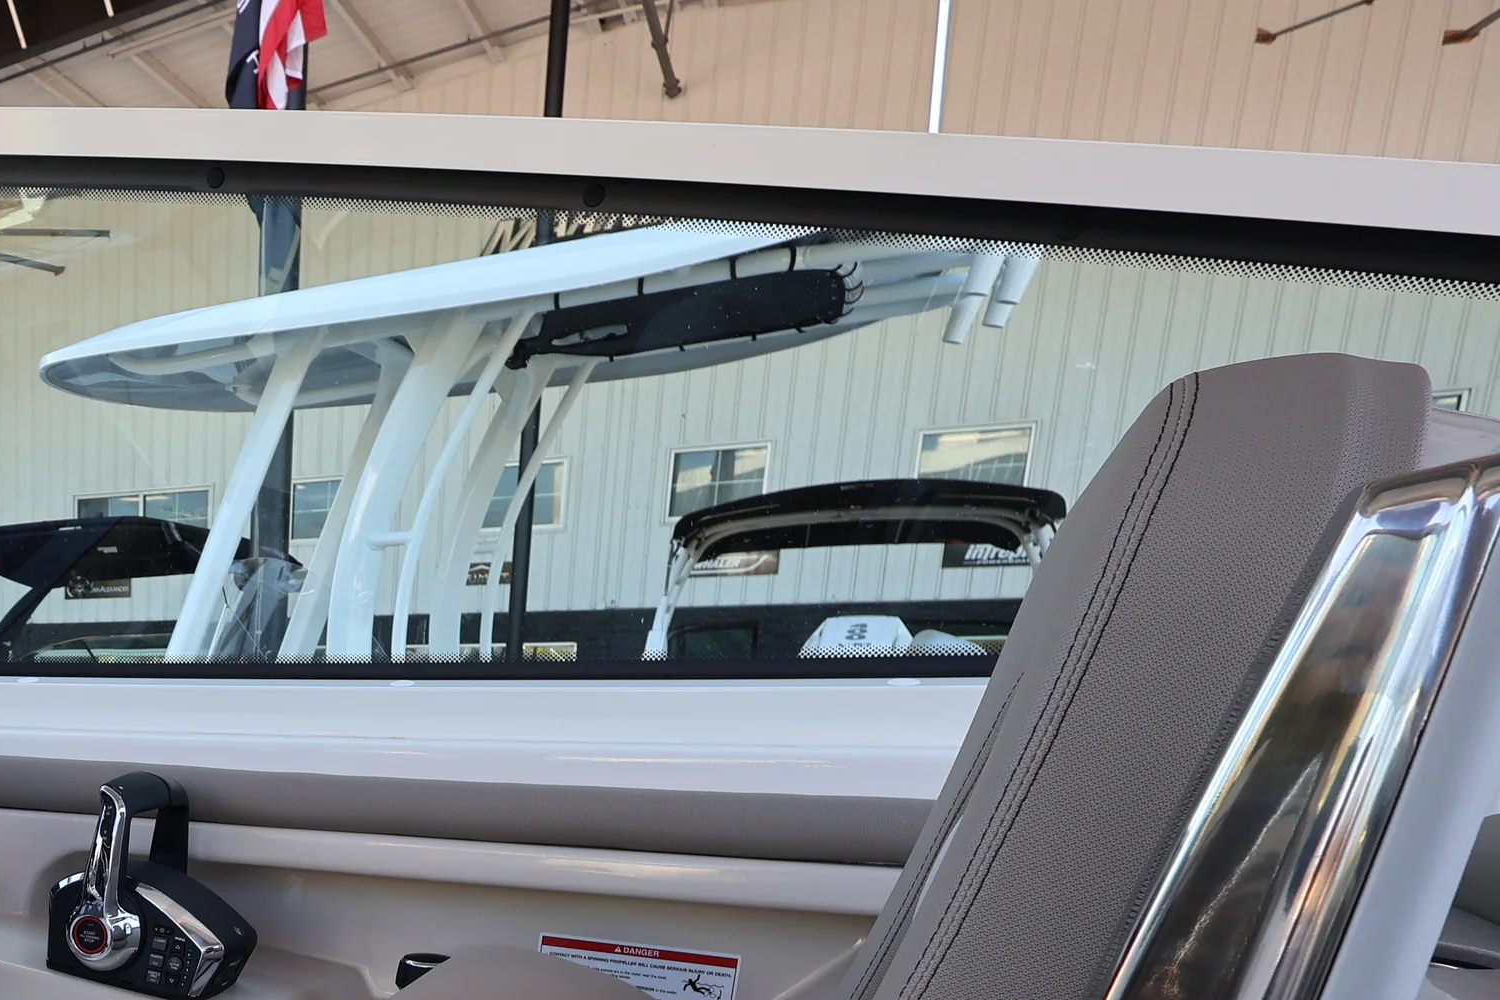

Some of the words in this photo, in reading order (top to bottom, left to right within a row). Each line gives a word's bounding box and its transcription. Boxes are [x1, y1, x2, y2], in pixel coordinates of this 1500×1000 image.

[623, 946, 660, 958] DANGER
[609, 958, 637, 966] PROPELLER
[666, 965, 688, 973] SERIOUS
